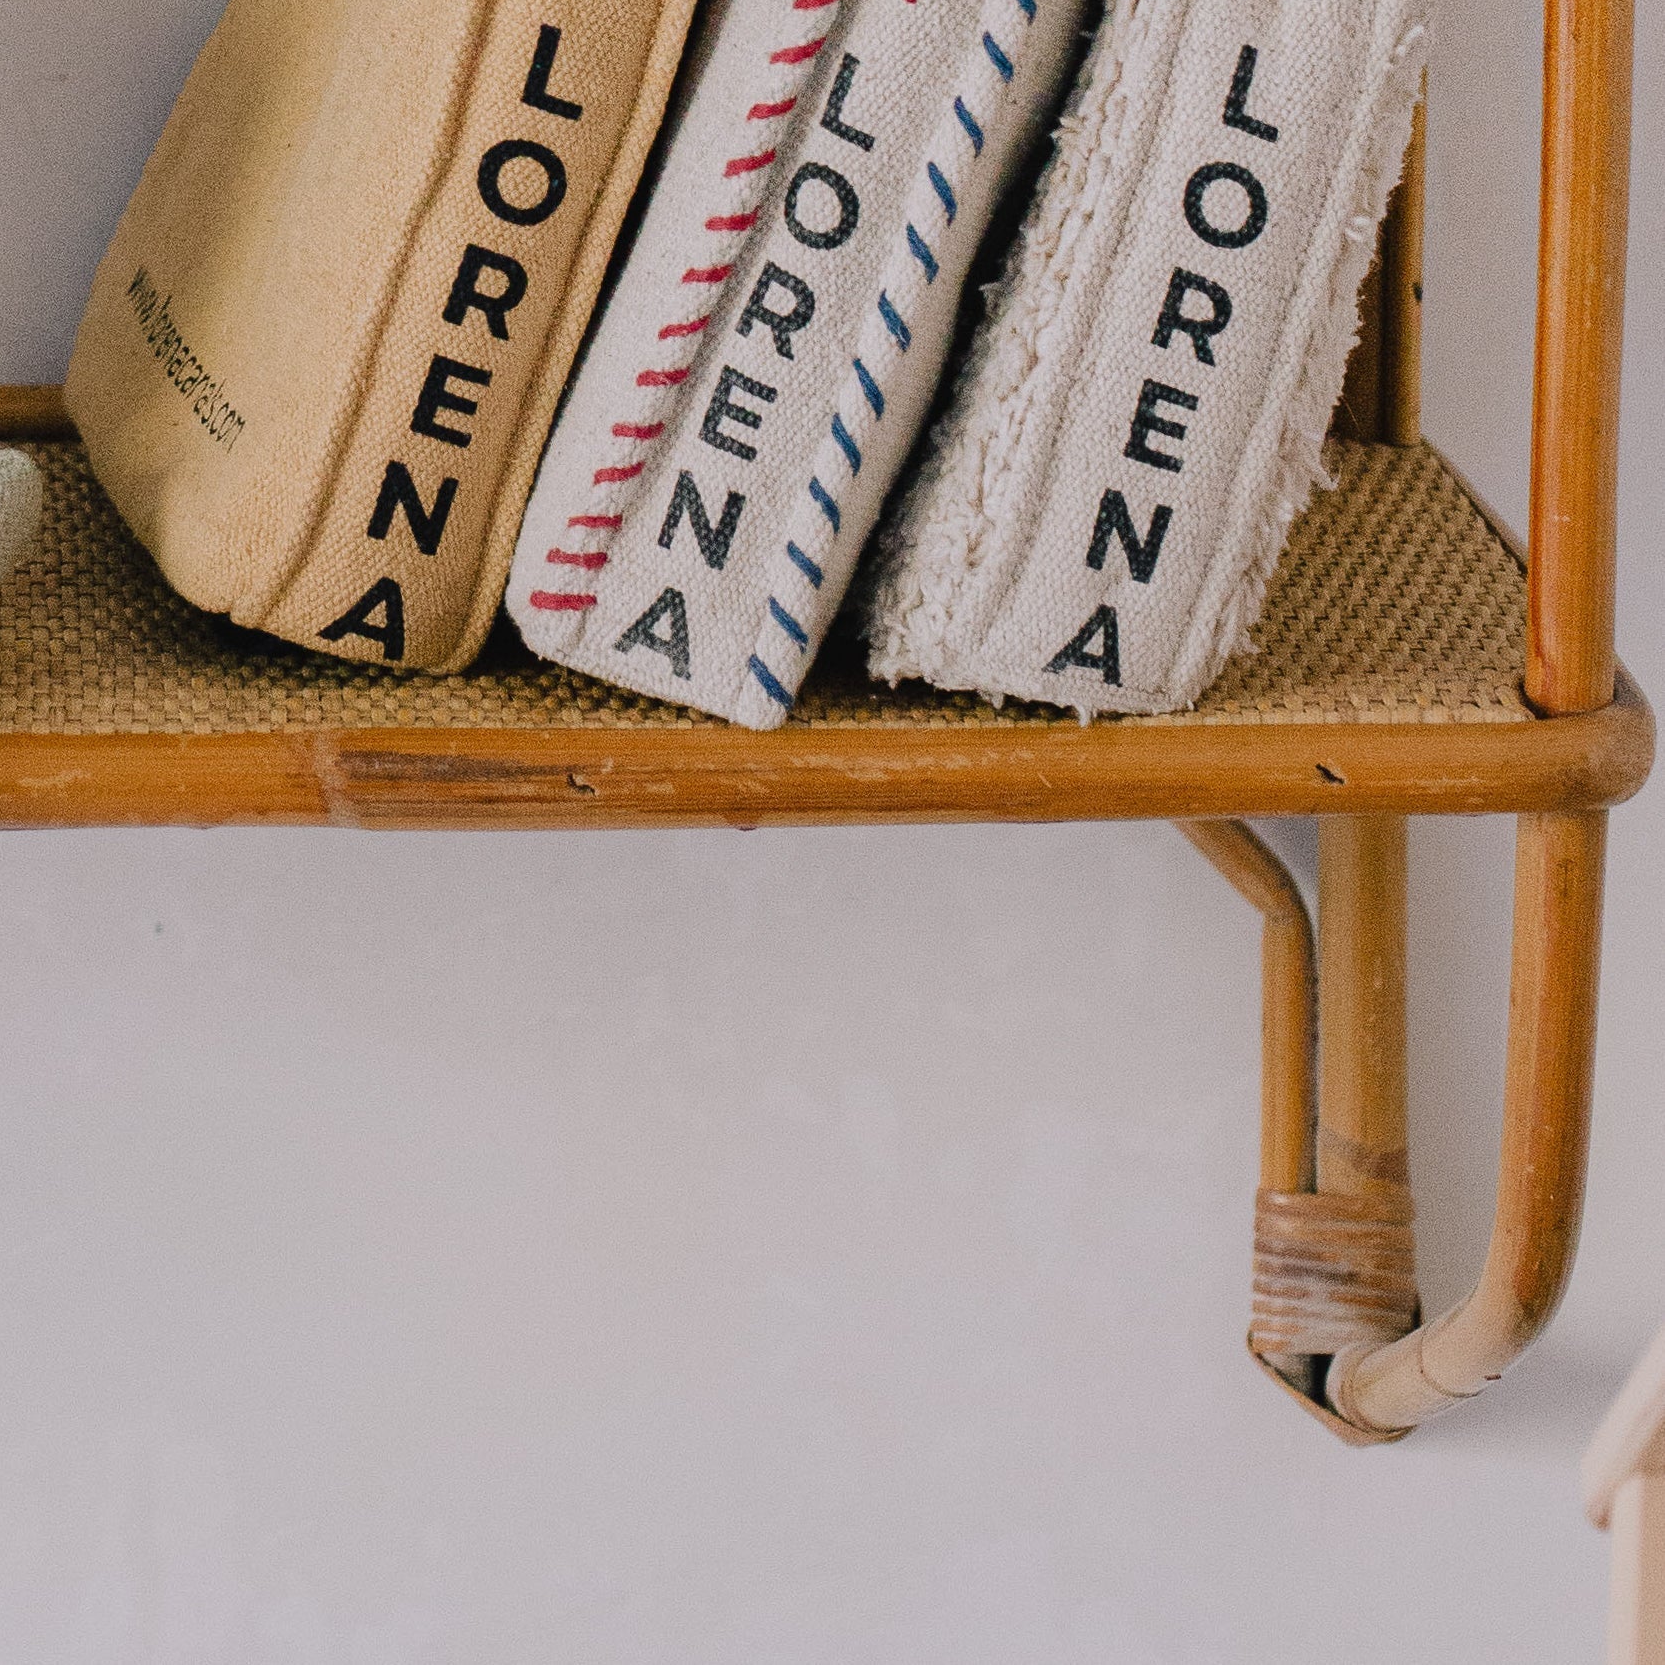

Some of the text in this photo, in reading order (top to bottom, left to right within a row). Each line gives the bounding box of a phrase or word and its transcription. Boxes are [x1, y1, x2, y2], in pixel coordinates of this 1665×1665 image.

[317, 23, 584, 662] LORENA
[614, 52, 876, 680] LORENA
[1043, 44, 1280, 688] LORENA
